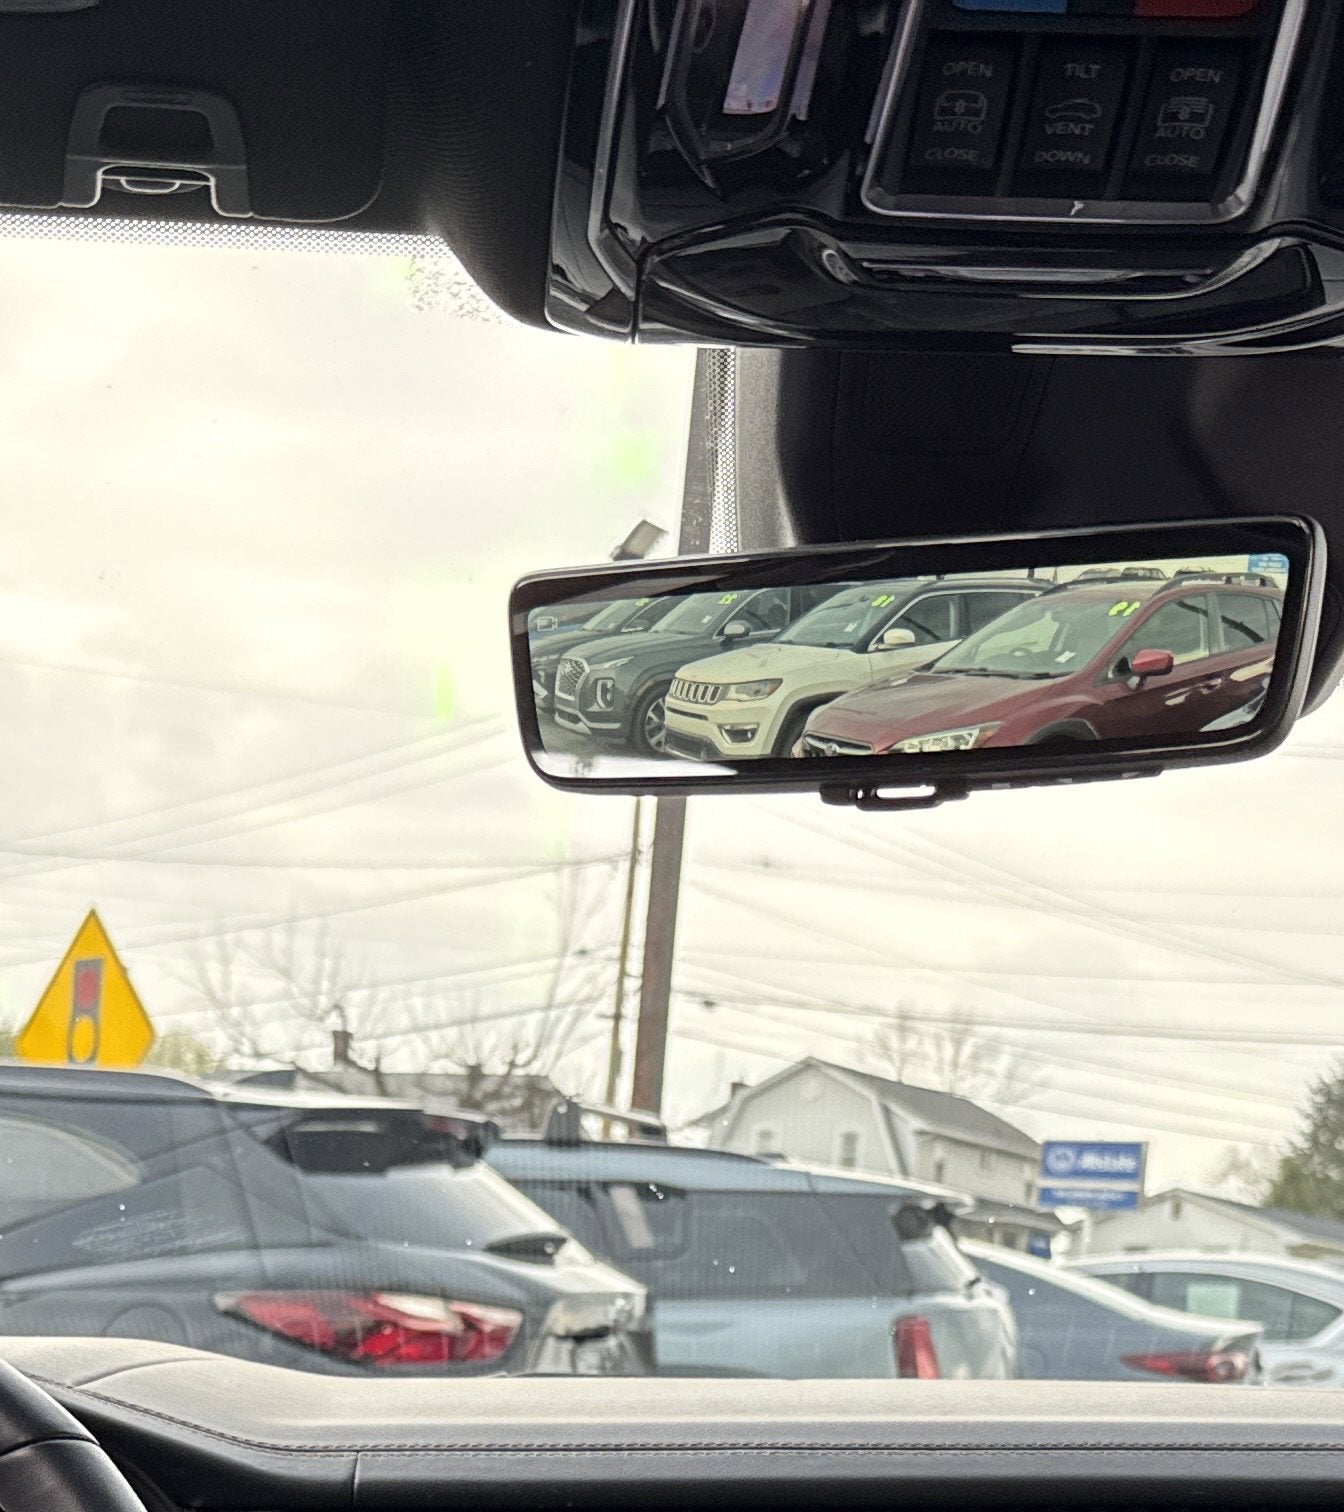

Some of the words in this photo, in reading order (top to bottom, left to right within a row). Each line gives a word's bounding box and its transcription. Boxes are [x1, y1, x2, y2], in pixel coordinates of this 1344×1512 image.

[942, 61, 993, 78] OPEN
[1064, 62, 1101, 79] TILT
[1169, 67, 1223, 83] OPEN
[933, 119, 983, 134] AUTO
[1043, 122, 1095, 137] VENT
[1155, 126, 1206, 140] AUTO
[923, 147, 980, 162] CLOSE
[1033, 150, 1091, 165] DOWN
[1144, 153, 1201, 167] CLOSE
